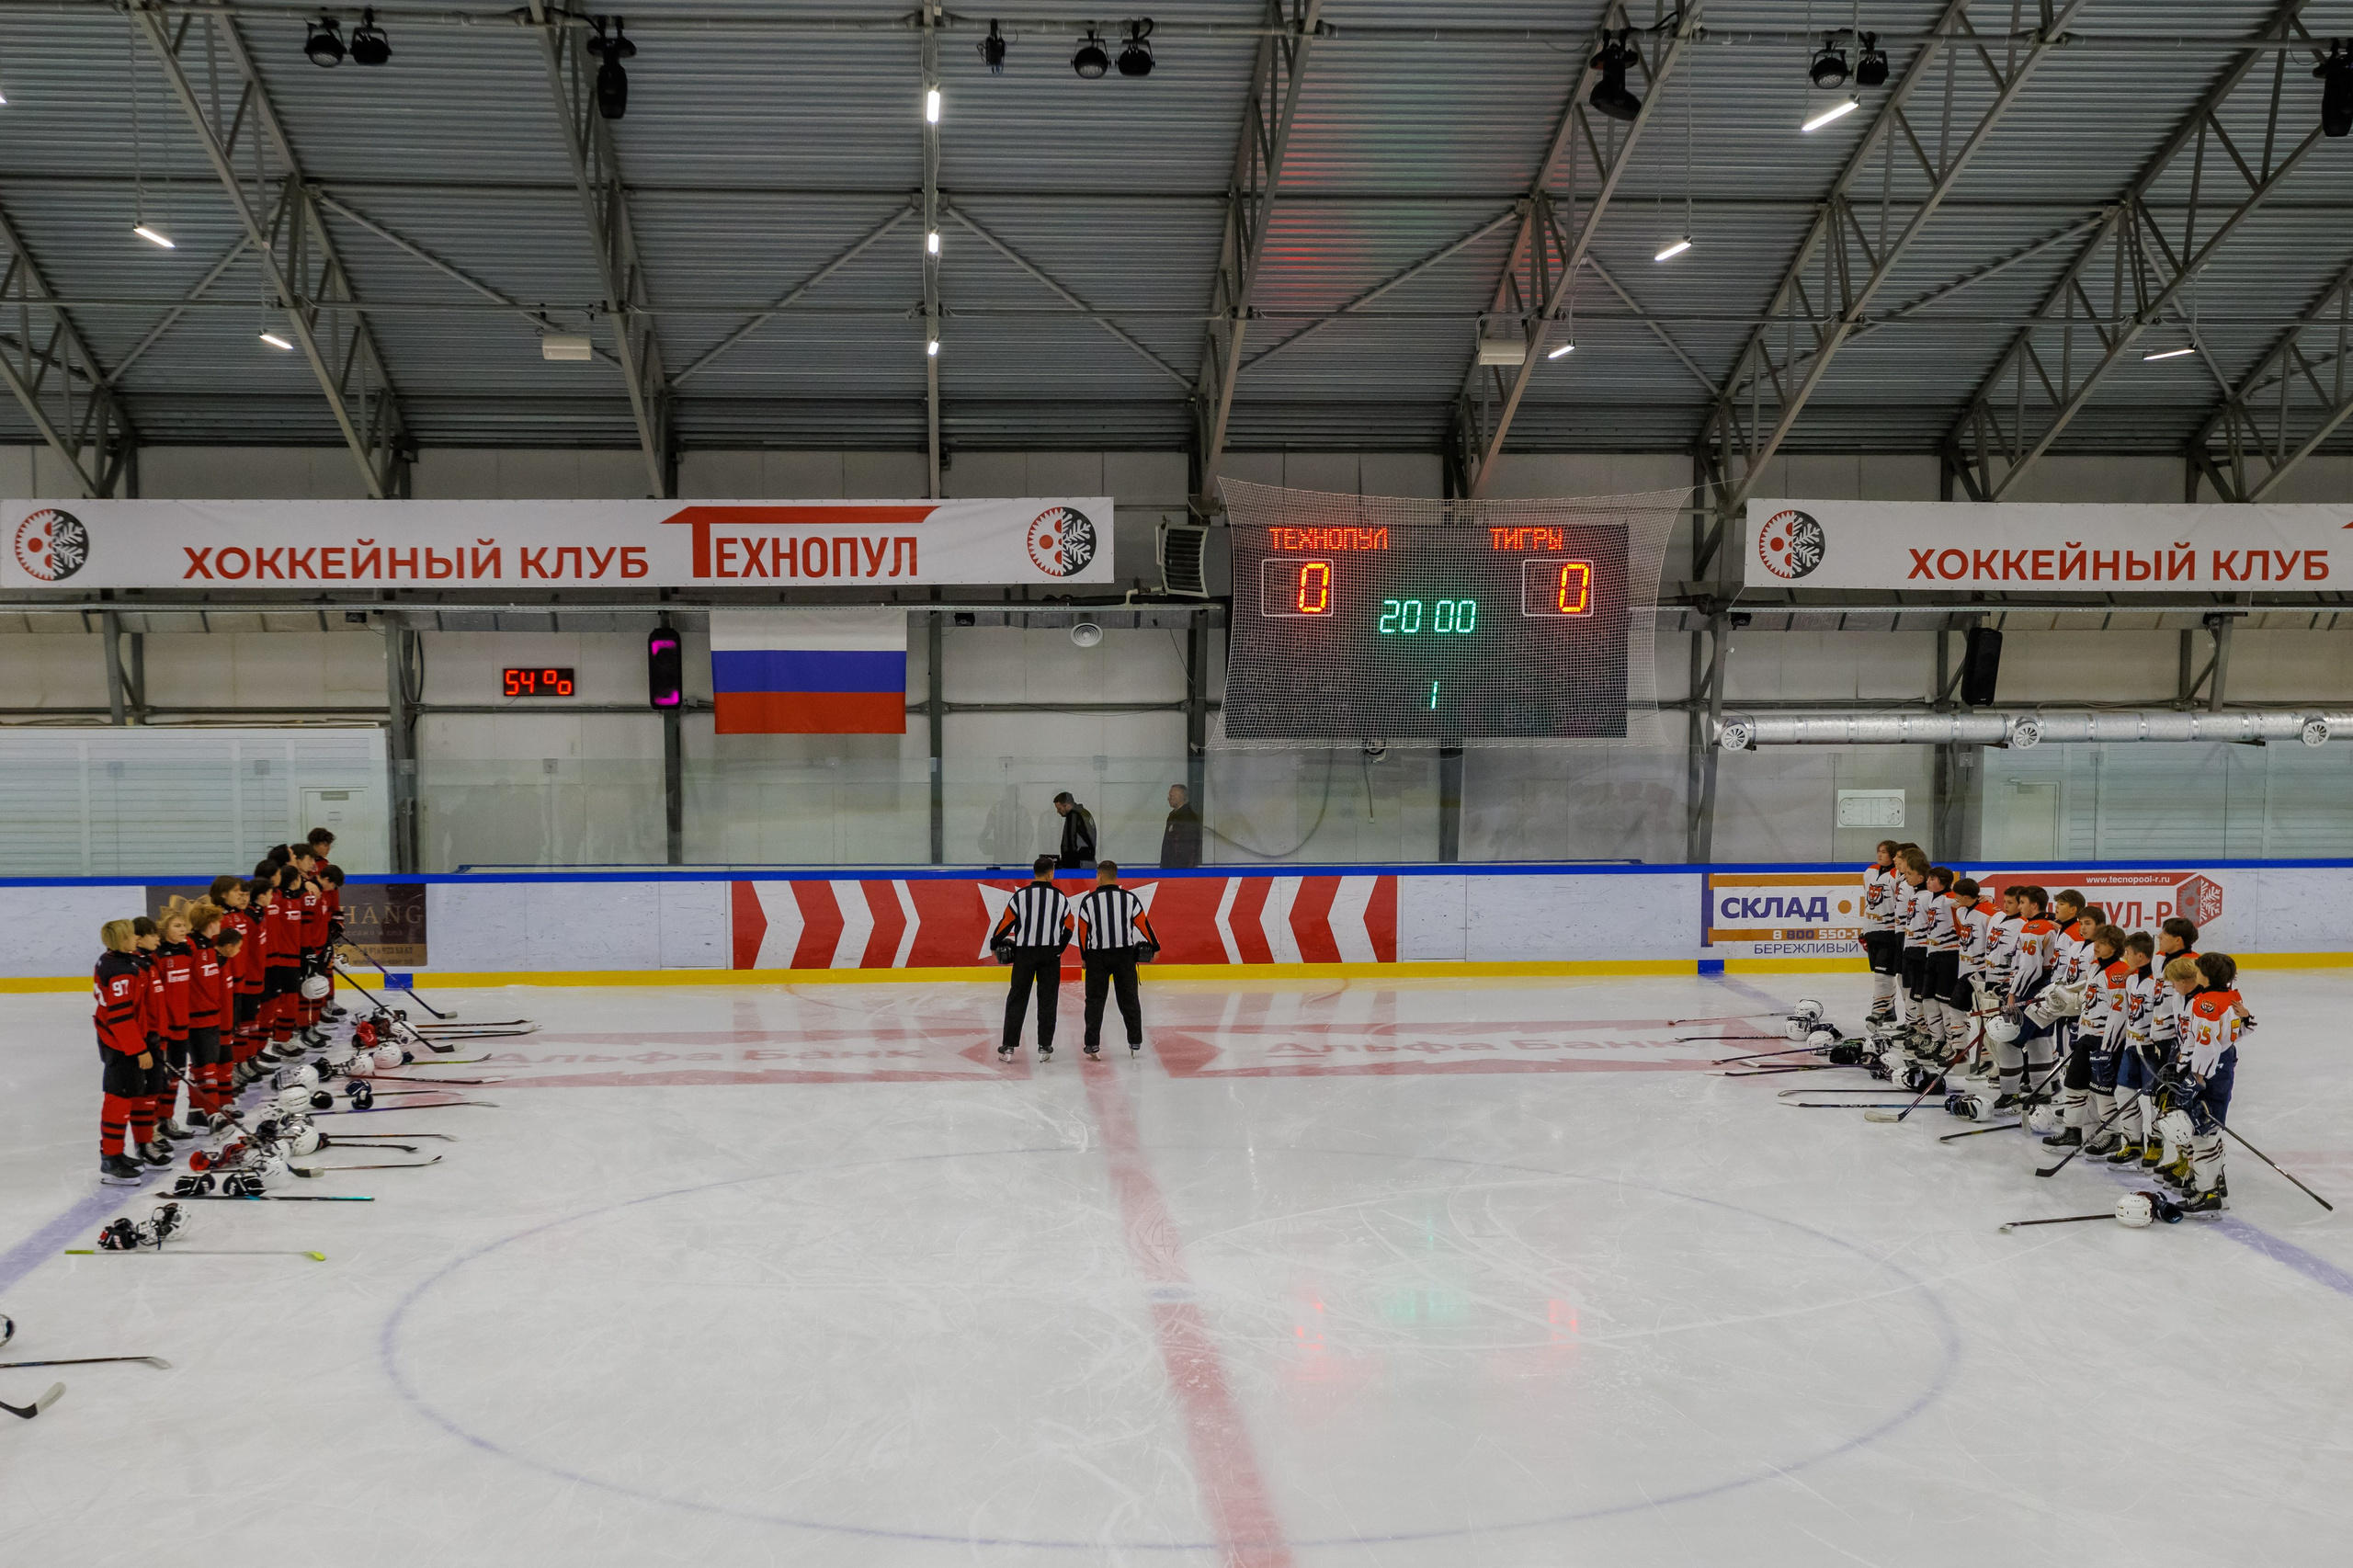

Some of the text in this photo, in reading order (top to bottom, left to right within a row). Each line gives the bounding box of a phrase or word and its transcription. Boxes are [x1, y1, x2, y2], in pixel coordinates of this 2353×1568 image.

[183, 506, 941, 580] ХОККЕЙНЫЙ КЛУБ ТЕХНОПУЛ
[1269, 528, 1388, 550] ТЕХНОПУЛ
[1489, 528, 1563, 550] ТИГРЫ
[1908, 541, 2329, 581] ХОККЕЙНЫЙ КЛУБ
[1298, 562, 1329, 612] 0
[1559, 563, 1589, 612] 0
[2086, 875, 2170, 885] www.tecnopool-r.ru
[1721, 897, 1829, 922] СКЛАД
[1772, 928, 1863, 939] 8 800 550-1
[1754, 940, 1859, 954] БЕРЕЖЛИВЫЙ
[112, 980, 129, 996] 97
[486, 1049, 923, 1065] Альфа Банк
[1267, 1039, 1695, 1054] Альфа Банк
